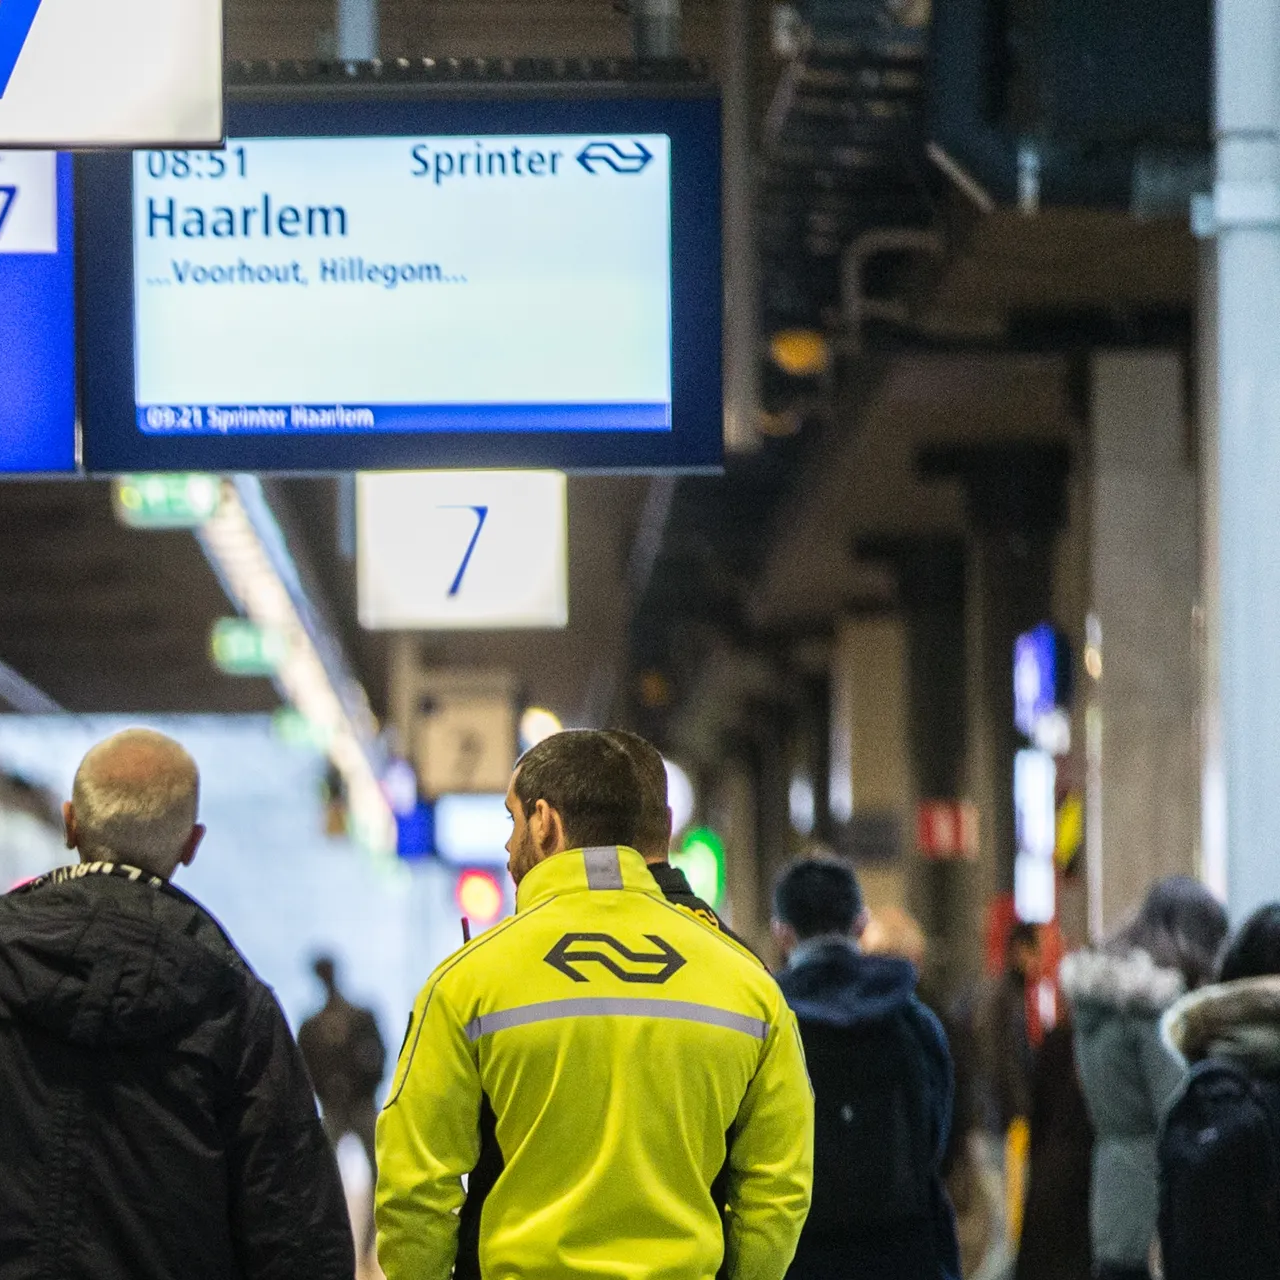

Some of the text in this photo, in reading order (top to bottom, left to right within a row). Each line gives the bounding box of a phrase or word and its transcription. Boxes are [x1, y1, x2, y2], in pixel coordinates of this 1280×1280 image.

[147, 142, 563, 186] 08:51 Sprinter
[146, 192, 349, 239] Haarlem
[206, 404, 288, 433] Sprinter
[290, 403, 375, 429] Haarlem
[436, 505, 489, 598] 7
